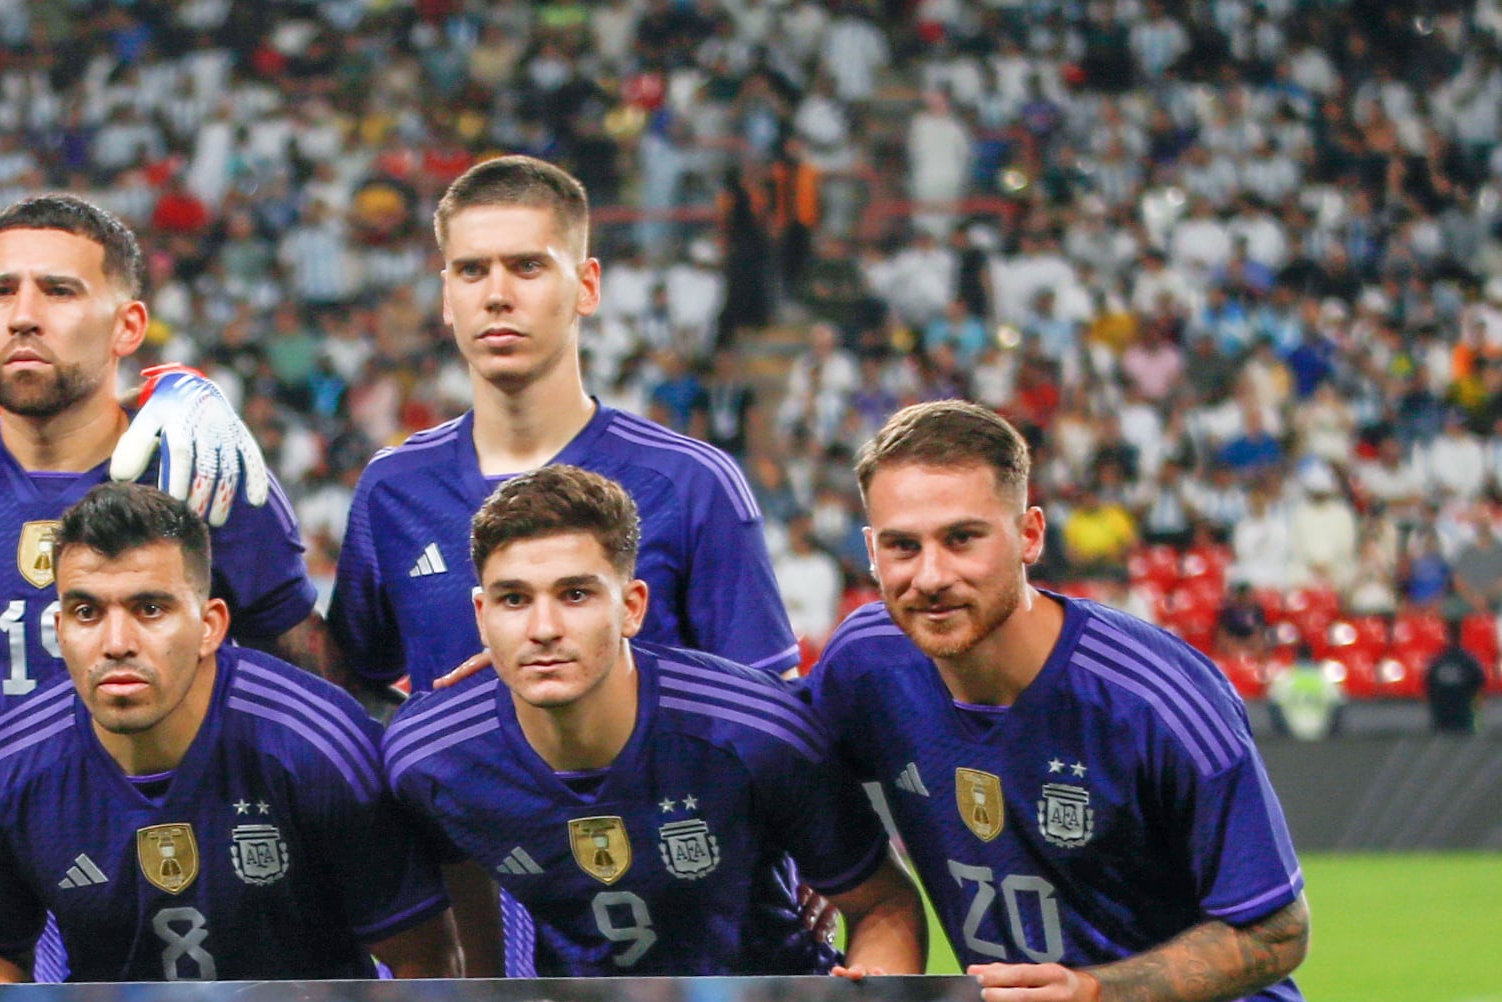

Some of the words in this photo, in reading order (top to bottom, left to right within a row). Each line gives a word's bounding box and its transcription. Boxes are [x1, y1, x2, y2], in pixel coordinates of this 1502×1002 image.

[1050, 801, 1080, 831] AFA
[246, 842, 275, 869] AFA
[675, 837, 706, 863] AFA
[591, 891, 658, 968] 9
[947, 859, 1065, 965] 20
[151, 906, 218, 982] 8
